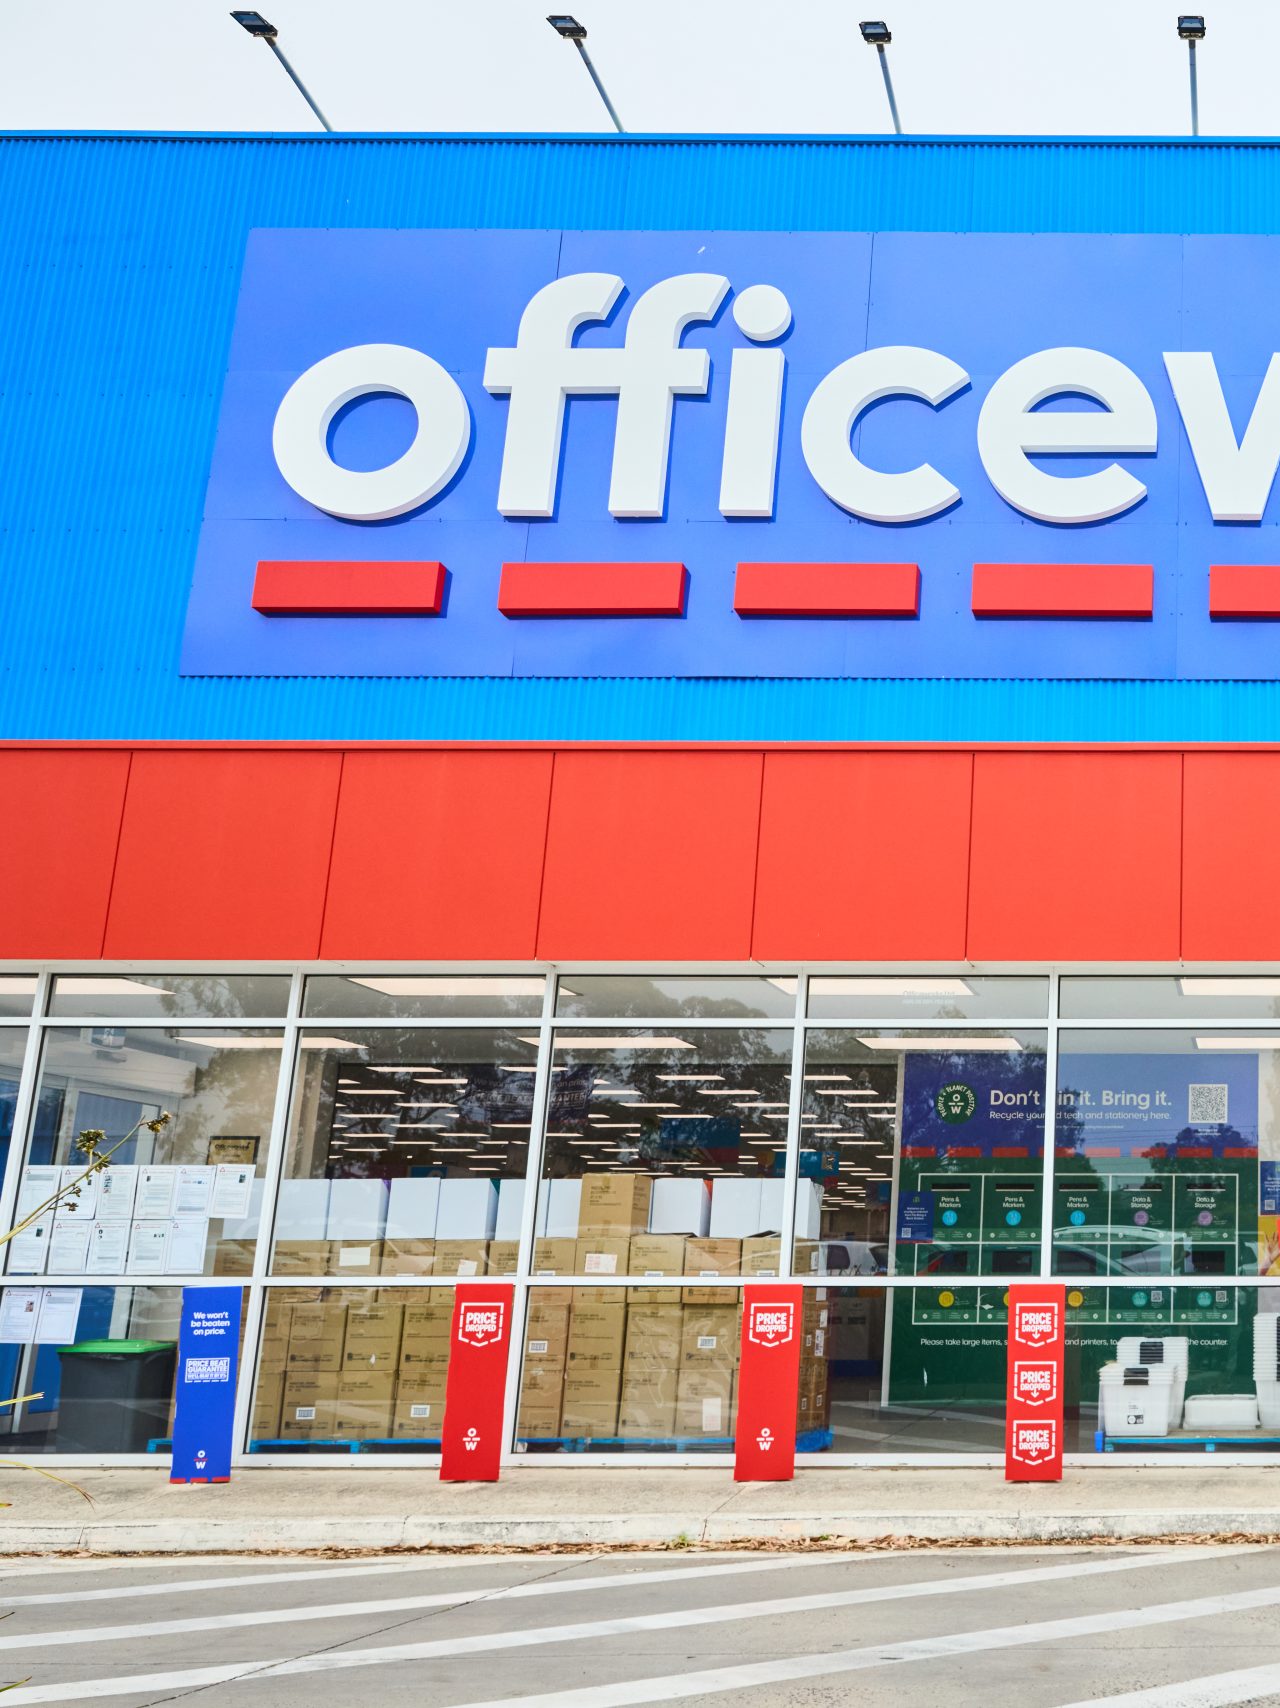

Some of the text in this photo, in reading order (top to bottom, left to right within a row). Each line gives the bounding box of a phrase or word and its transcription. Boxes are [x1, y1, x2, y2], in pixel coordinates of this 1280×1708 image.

[990, 1089, 1172, 1110] Don't in it. Bring it.
[990, 1111, 1024, 1121] Recycle
[1063, 1111, 1083, 1120] tech
[1085, 1111, 1101, 1120] and
[1104, 1111, 1149, 1122] stationery
[1150, 1111, 1171, 1120] here.
[193, 1312, 206, 1320] We
[466, 1312, 497, 1324] PRICE
[756, 1312, 787, 1325] PRICE
[1021, 1312, 1052, 1325] PRICE
[204, 1328, 226, 1337] price.
[465, 1324, 497, 1333] DROPPED
[755, 1324, 787, 1333] DROPPED
[1021, 1324, 1052, 1333] DROPPED
[920, 1338, 945, 1346] Please
[945, 1338, 961, 1346] take
[961, 1338, 981, 1348] large
[981, 1338, 1002, 1348] items,
[1064, 1338, 1080, 1346] and
[1080, 1338, 1108, 1348] printers,
[1020, 1371, 1050, 1383] PRICE
[1020, 1383, 1050, 1391] DROPPED
[1019, 1430, 1050, 1442] PRICE
[1019, 1442, 1050, 1451] DROPPED
